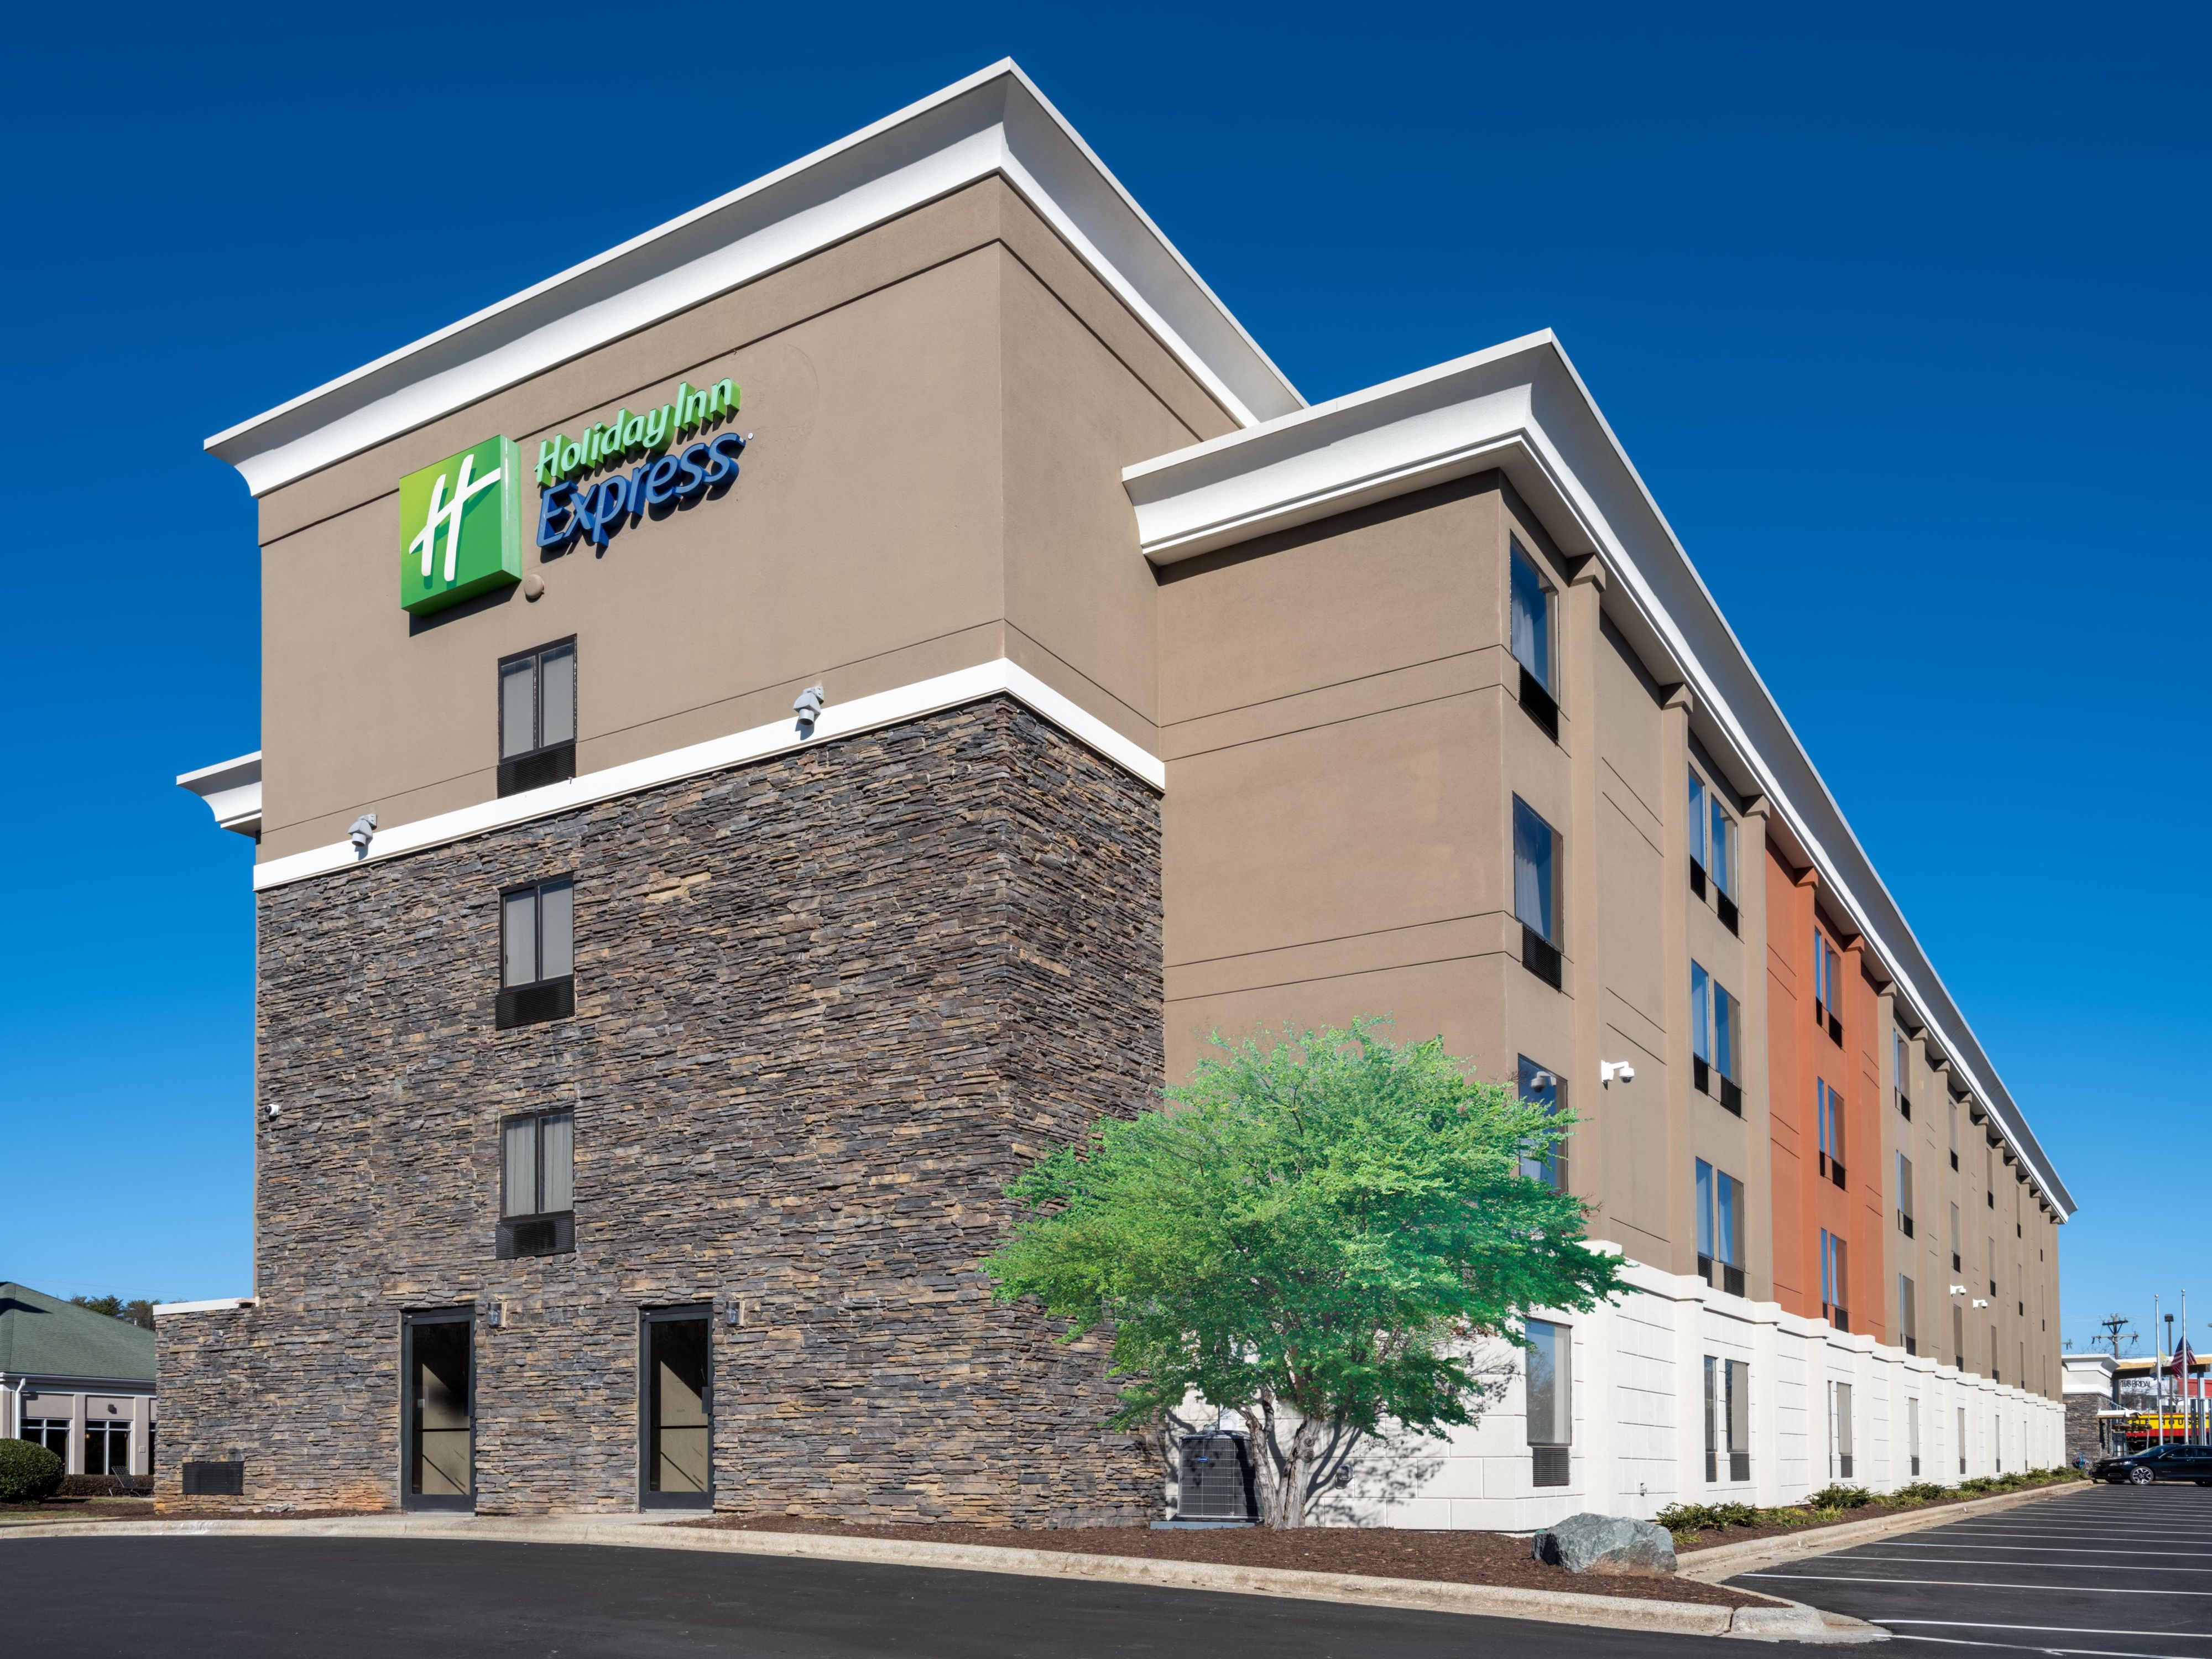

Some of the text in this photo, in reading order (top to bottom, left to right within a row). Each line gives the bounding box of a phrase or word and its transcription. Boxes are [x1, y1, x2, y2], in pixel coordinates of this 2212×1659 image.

[534, 378, 741, 487] Holiday Inn
[536, 433, 746, 548] Express
